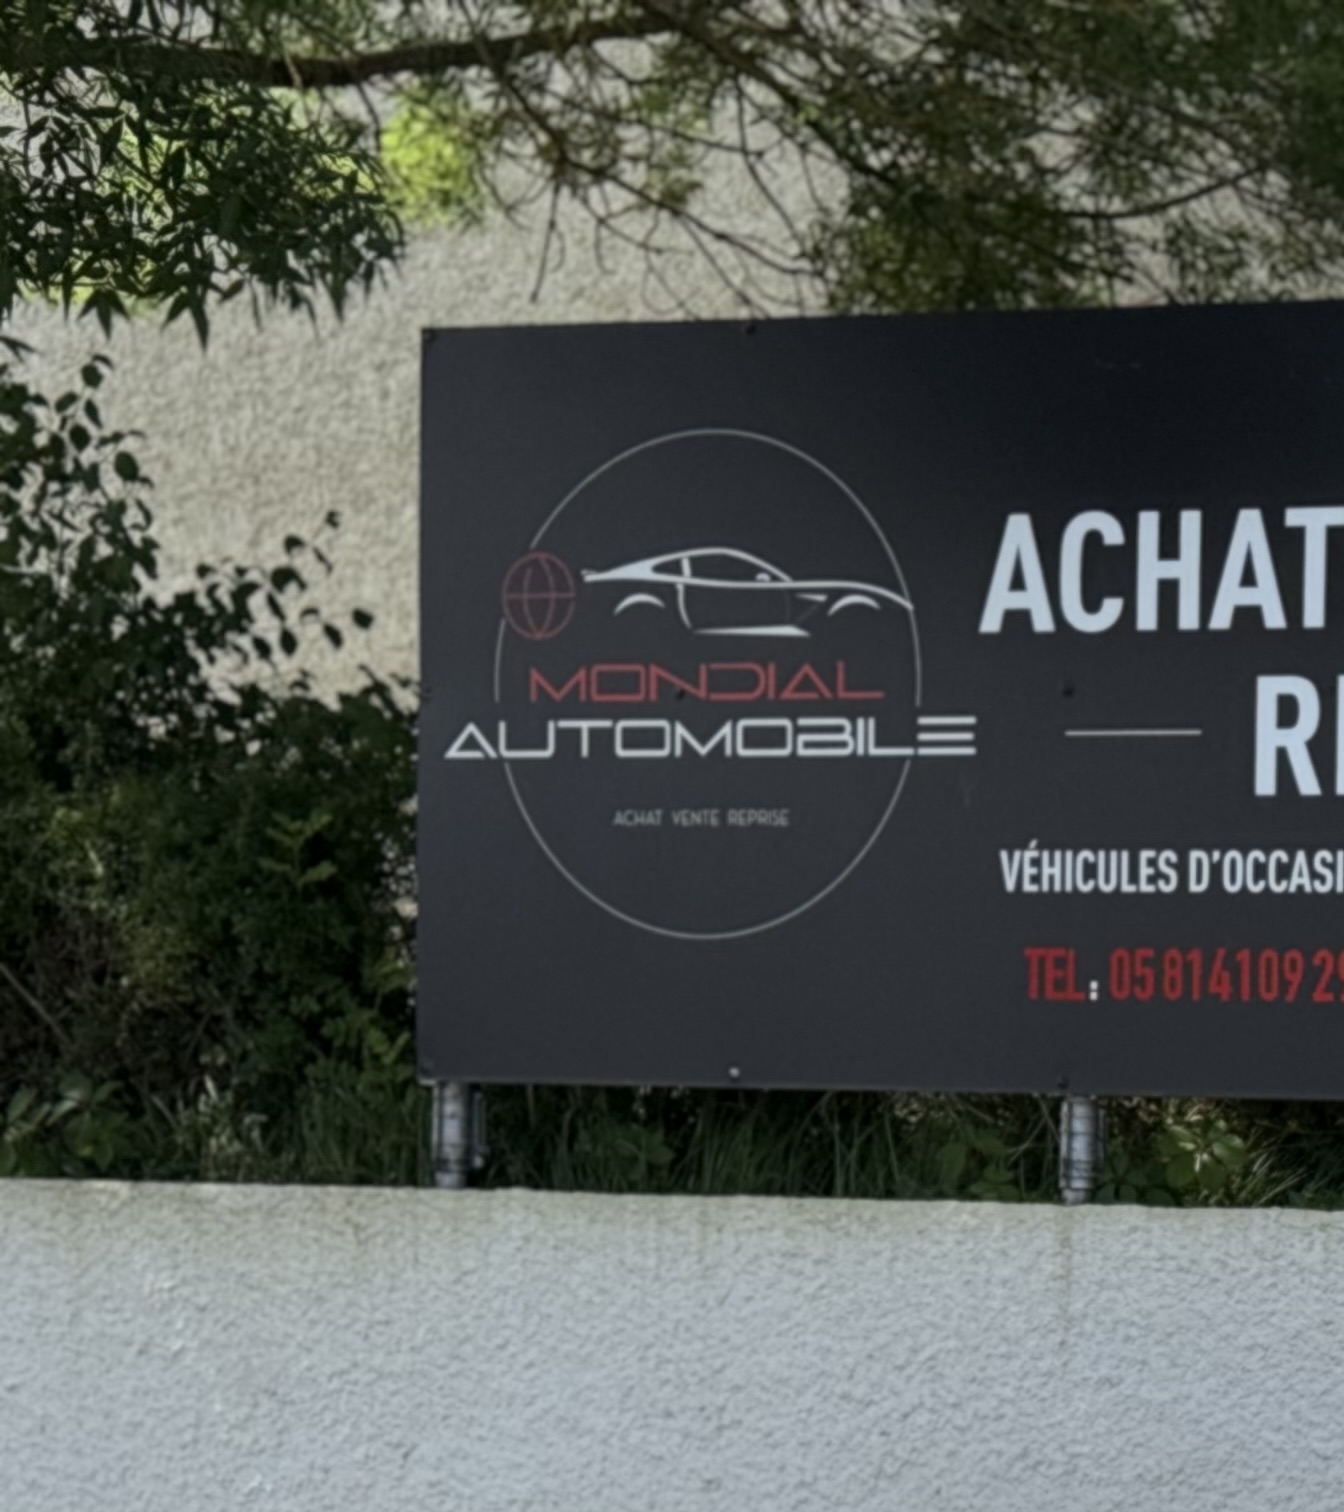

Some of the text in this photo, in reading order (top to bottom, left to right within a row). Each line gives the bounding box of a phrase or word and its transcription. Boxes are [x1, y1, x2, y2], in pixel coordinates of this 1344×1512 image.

[530, 662, 882, 703] MONDIAL
[444, 716, 977, 759] AUTOMOBILE
[613, 808, 789, 827] ACHAT VENTE REPRISE
[1000, 840, 1178, 893] VÉHICULES
